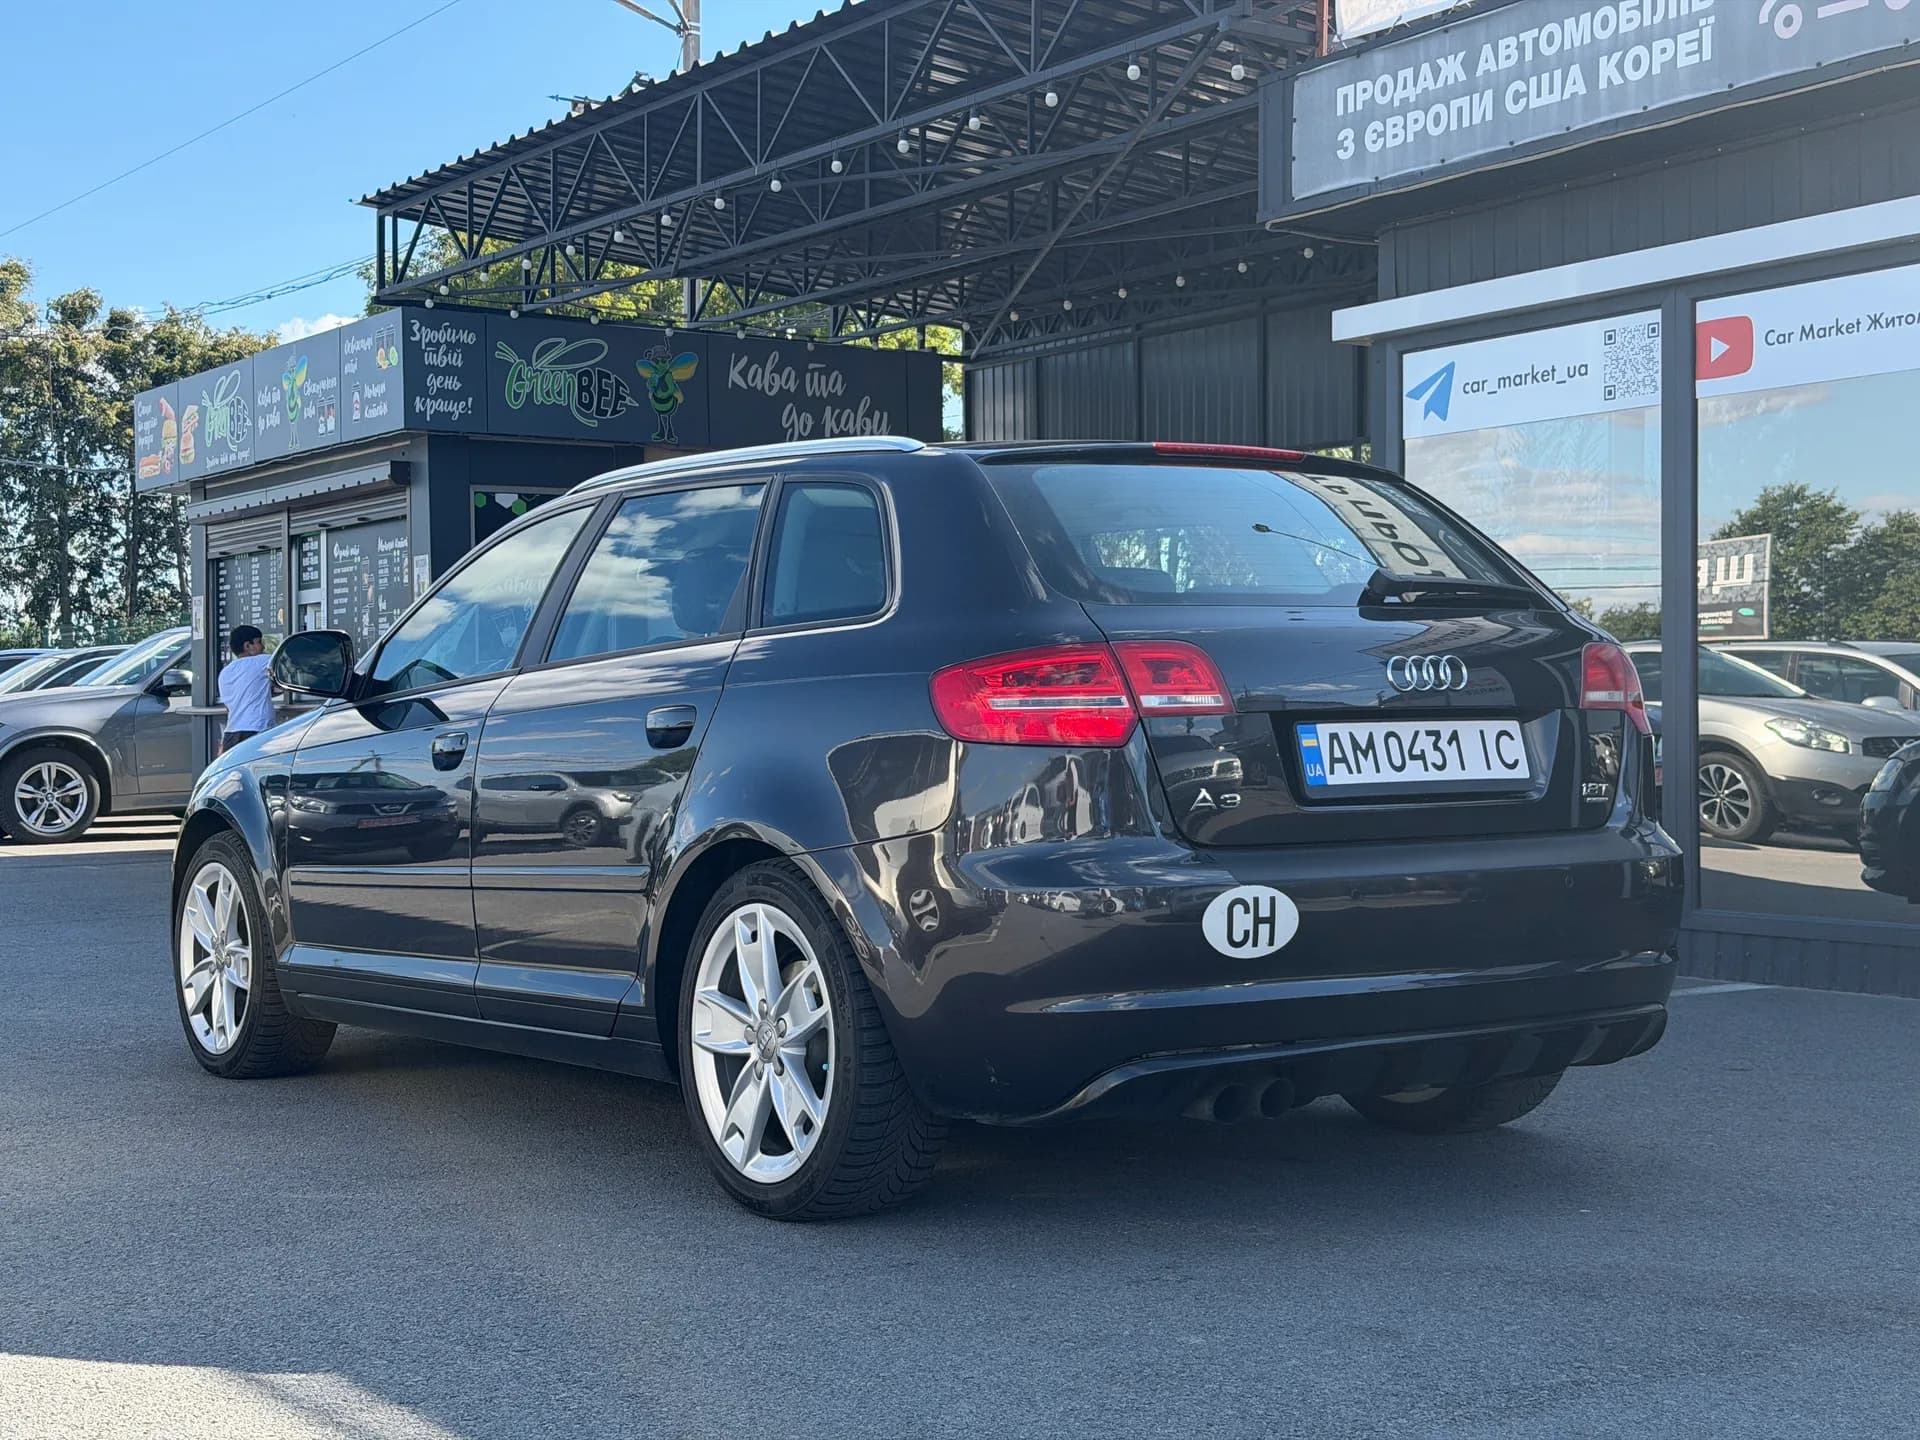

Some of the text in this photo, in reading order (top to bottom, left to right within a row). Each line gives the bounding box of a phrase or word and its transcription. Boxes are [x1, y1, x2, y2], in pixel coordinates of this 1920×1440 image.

[1336, 51, 1467, 117] ПРОДАЖ
[1336, 15, 1716, 160] З ЄВРОПИ США КОРЕЇ
[410, 319, 477, 350] Зробимо
[1764, 311, 1920, 347] Car Market Жито
[424, 344, 463, 368] твій
[426, 373, 462, 396] день
[728, 350, 847, 398] Кава та
[1462, 363, 1589, 395] car_market_ua
[414, 396, 473, 422] краще!
[821, 396, 892, 438] кави
[1306, 763, 1325, 778] UA
[1190, 788, 1241, 811] A3
[1227, 896, 1276, 949] CH
